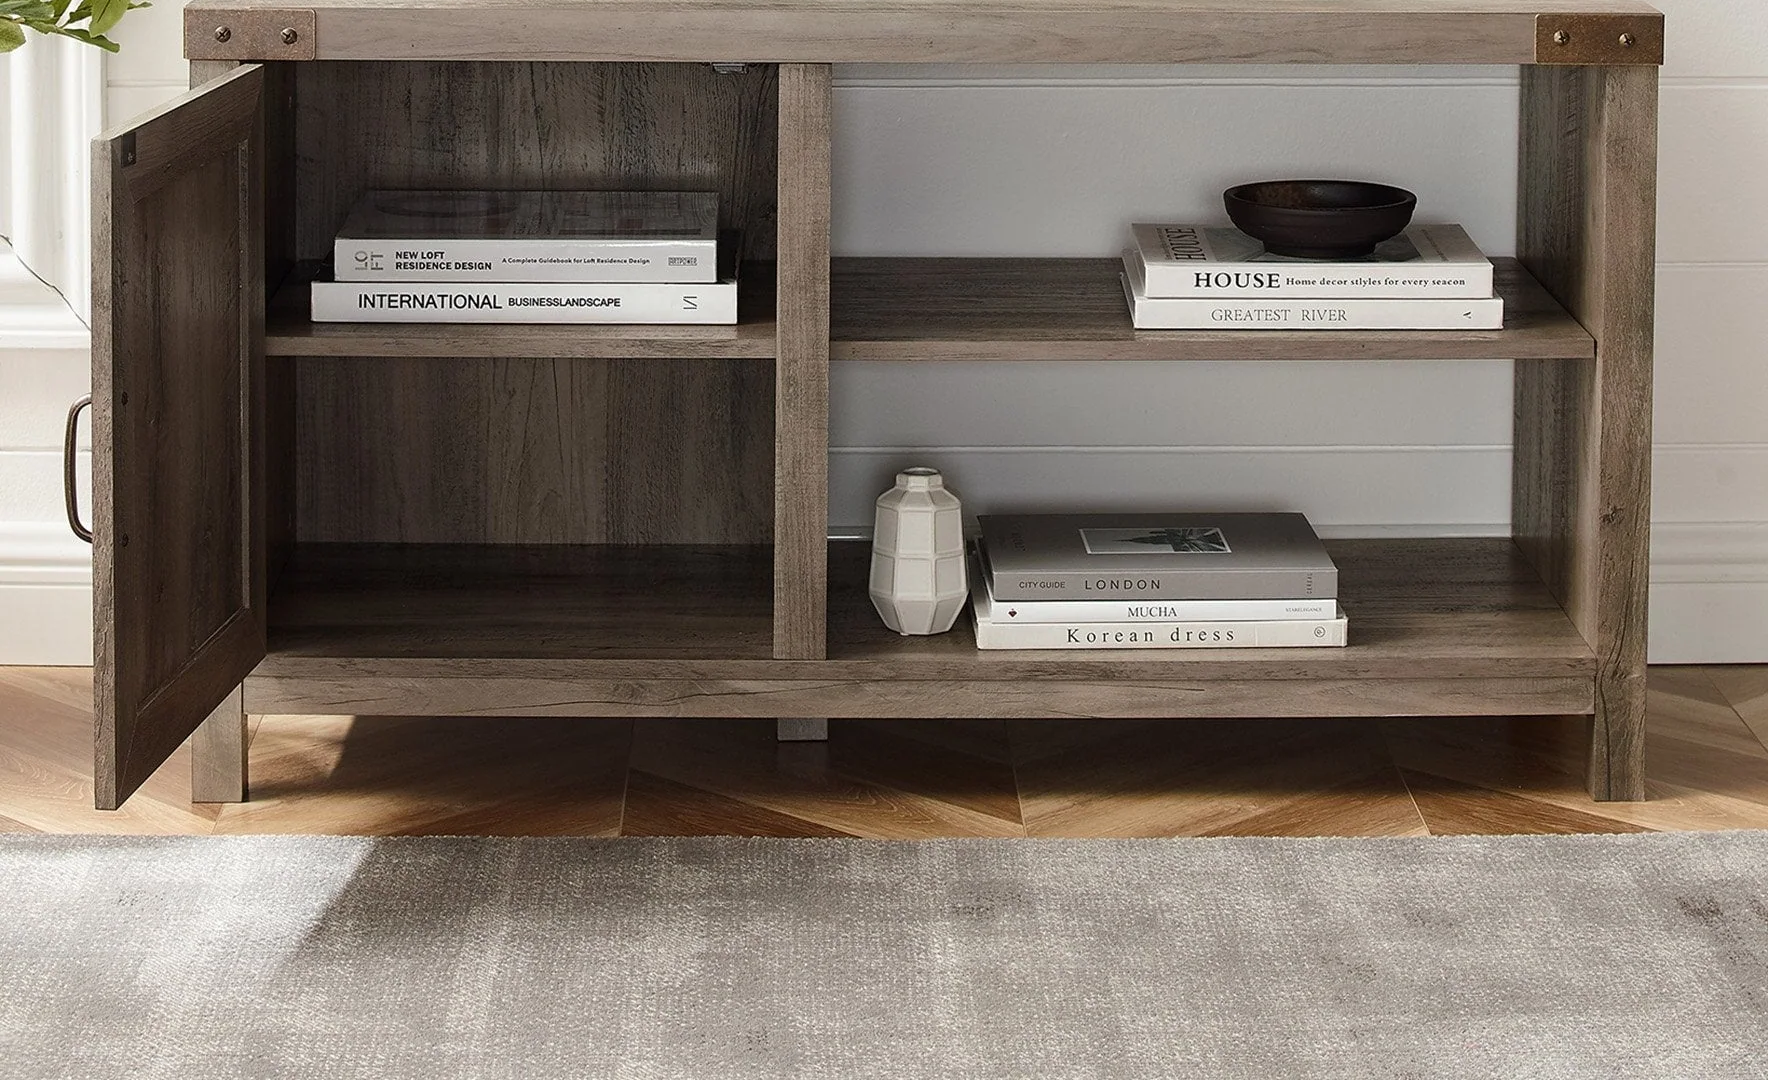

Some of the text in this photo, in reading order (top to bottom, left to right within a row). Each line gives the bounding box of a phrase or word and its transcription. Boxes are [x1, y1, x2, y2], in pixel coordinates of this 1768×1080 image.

[1165, 228, 1206, 261] HOUSE
[395, 251, 445, 259] NEW LOFT
[395, 262, 492, 270] RESIDENCE DESIGN
[628, 257, 651, 265] Design
[1194, 272, 1281, 288] HOUSE
[1285, 277, 1317, 286] Home
[1319, 277, 1348, 286] decor
[1384, 277, 1399, 286] for
[1401, 279, 1429, 288] every
[358, 294, 621, 309] INTERNATIONAL BUSINESSLANDSCAPE
[1211, 309, 1347, 321] GREATEST RIVER
[1018, 579, 1161, 590] CITY GUIDE LONDON
[1127, 607, 1178, 617] MUCHA
[1067, 627, 1235, 643] Korean dress
